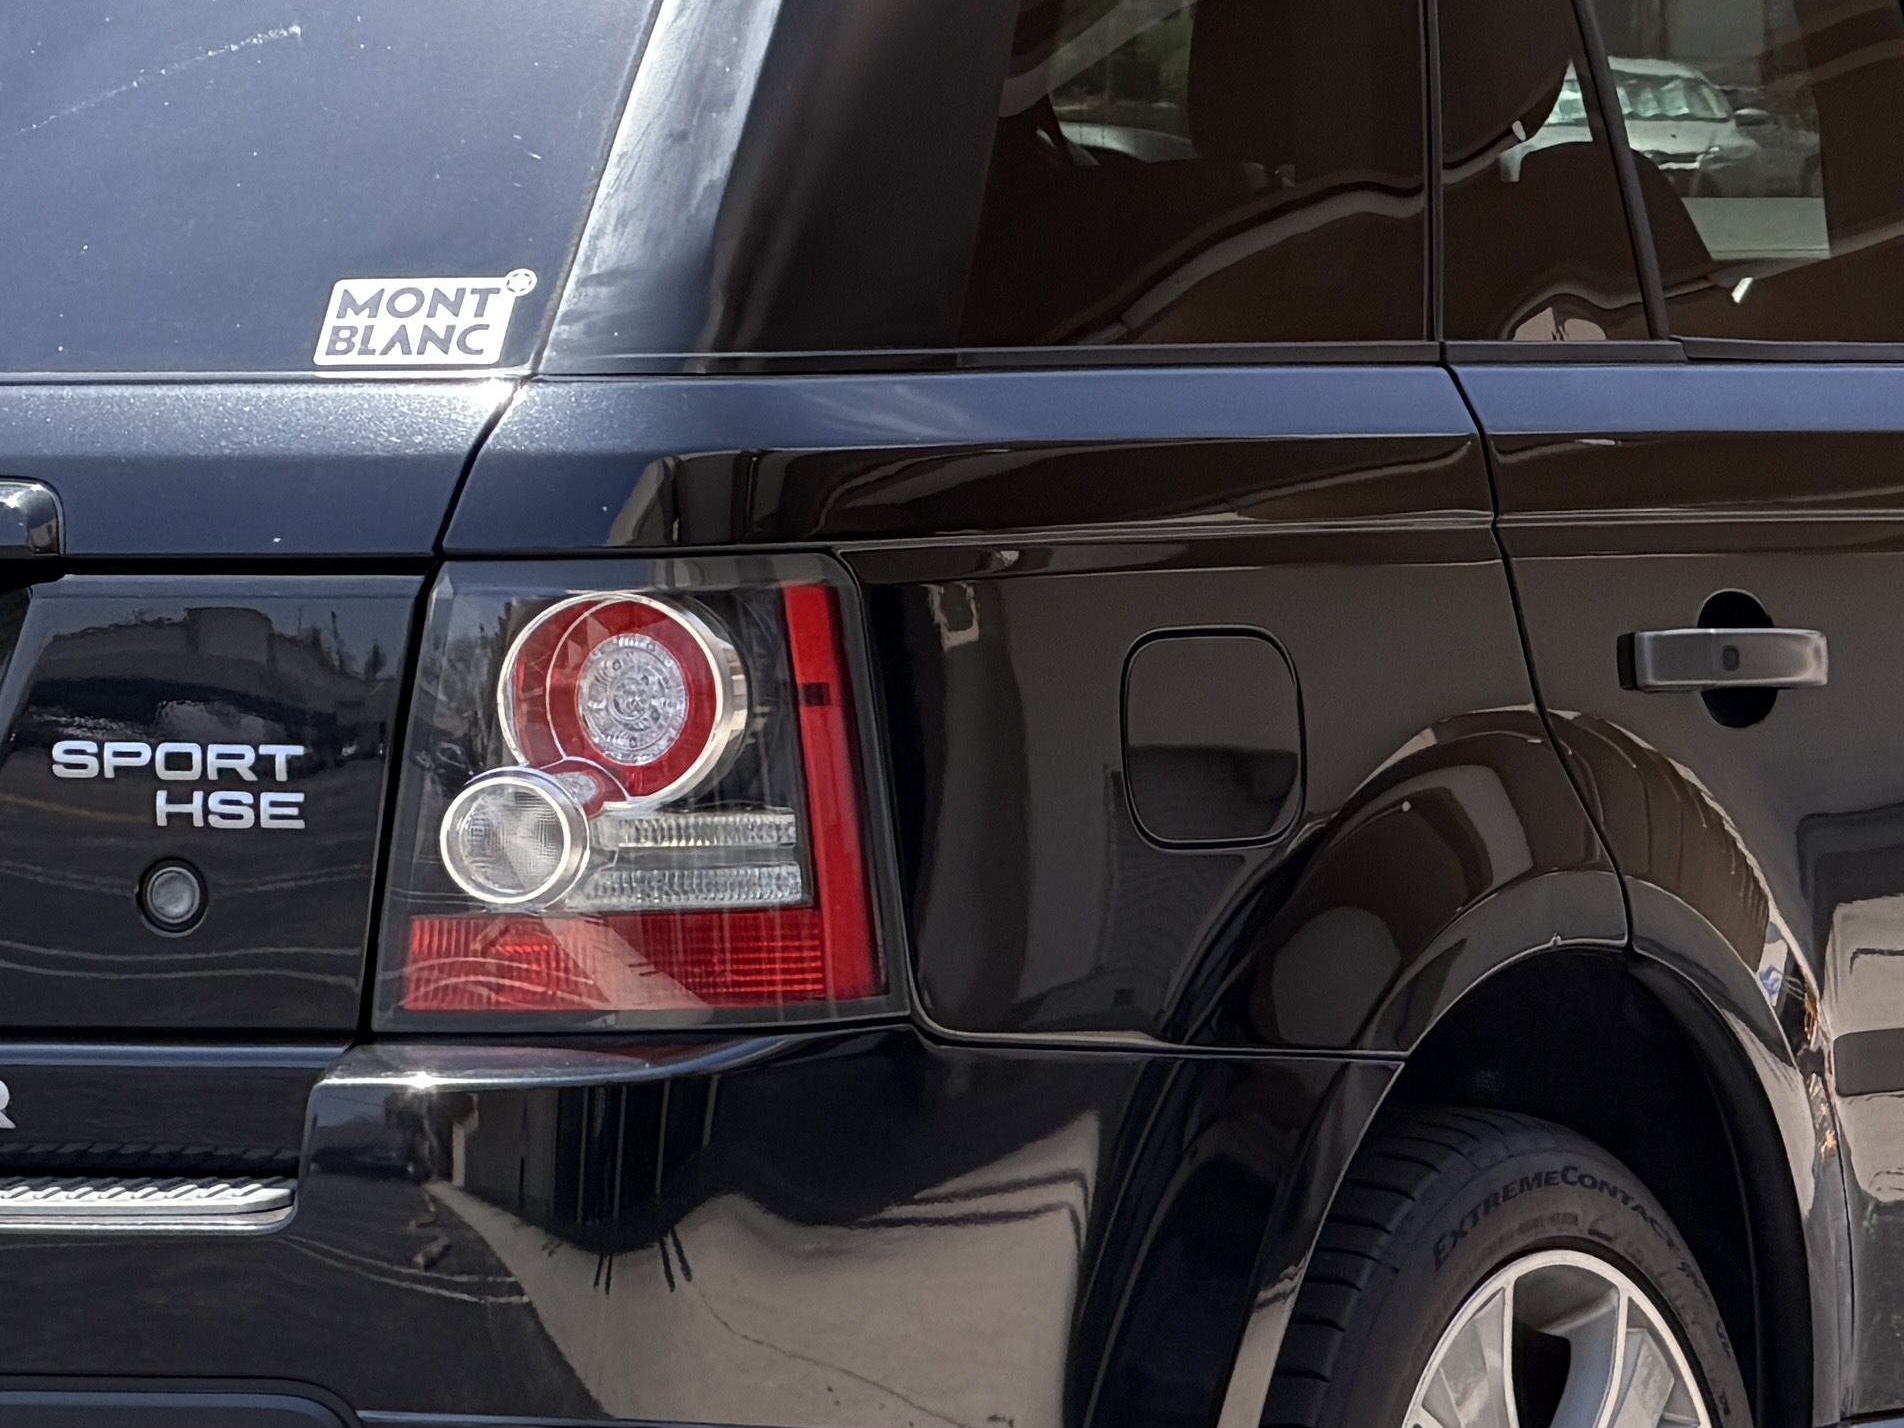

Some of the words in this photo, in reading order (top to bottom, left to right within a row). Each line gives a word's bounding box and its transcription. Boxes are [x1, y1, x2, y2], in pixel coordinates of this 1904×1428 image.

[336, 287, 501, 319] MONT
[325, 324, 490, 356] BLANC
[52, 740, 305, 781] SPORT
[156, 790, 306, 829] HSE
